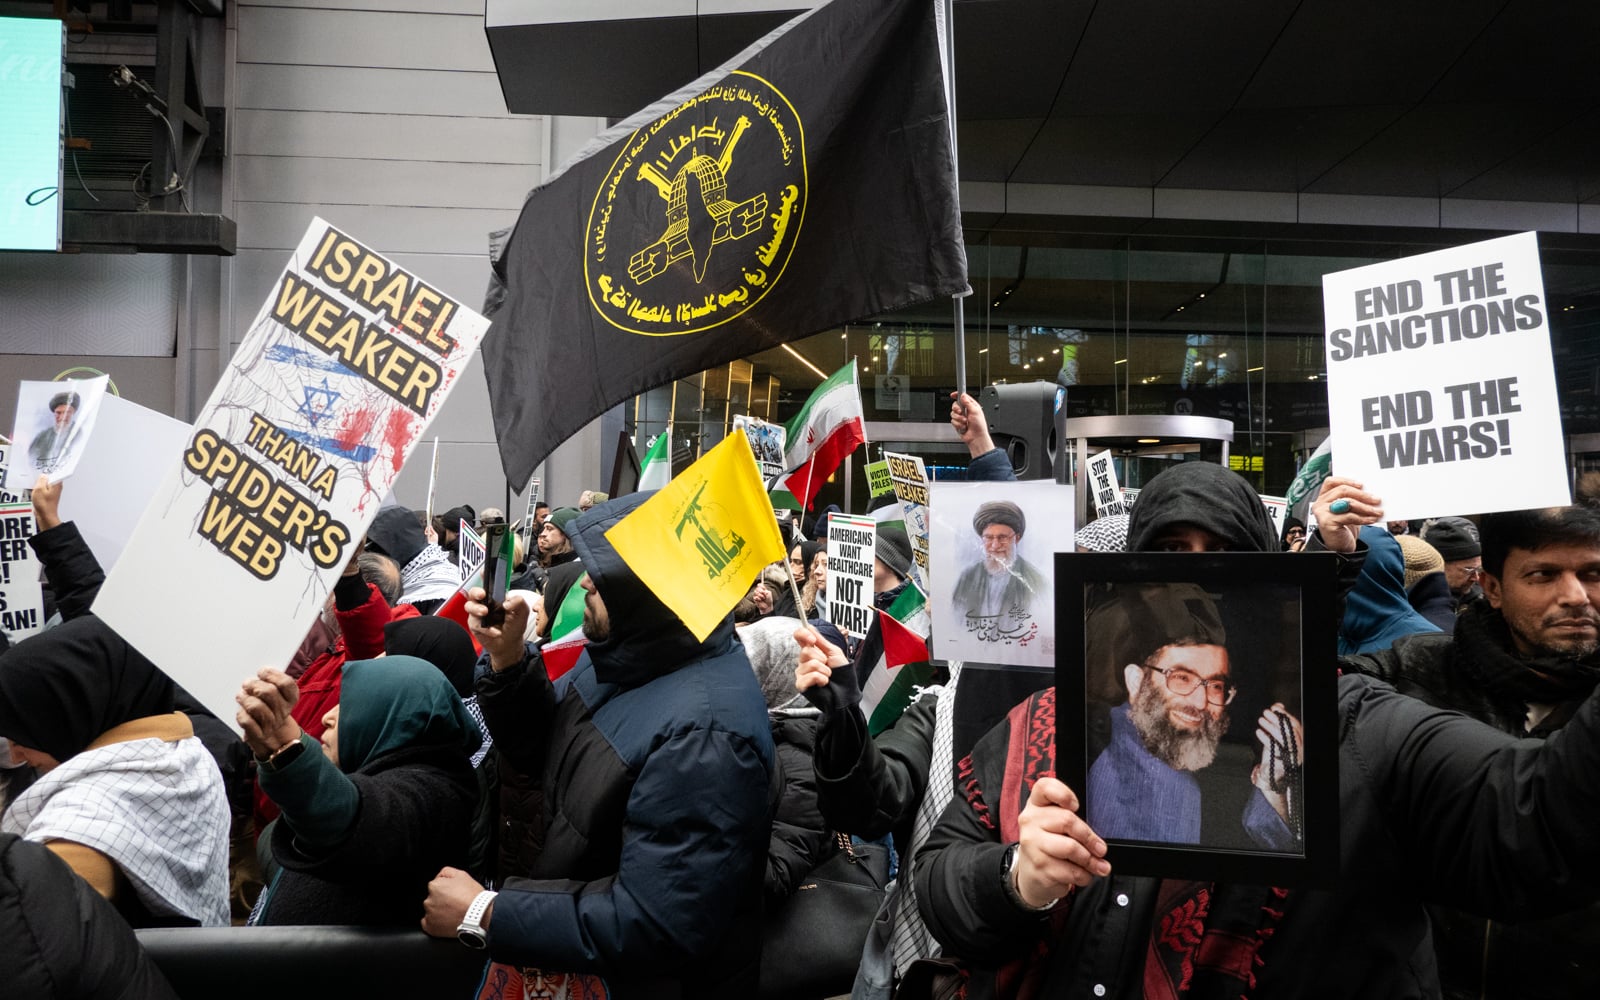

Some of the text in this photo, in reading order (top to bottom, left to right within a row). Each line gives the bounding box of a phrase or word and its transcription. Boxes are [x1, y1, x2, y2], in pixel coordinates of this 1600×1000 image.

[306, 228, 458, 356] ISRAEL
[1354, 262, 1508, 322] END THE
[273, 273, 441, 414] WEAKER
[1329, 294, 1544, 362] SANCTIONS
[1361, 376, 1522, 432] END THE
[246, 413, 337, 499] THAN A
[1373, 418, 1513, 470] WARS!
[888, 456, 924, 482] ISRAEL
[1092, 458, 1108, 476] STOP
[1098, 475, 1110, 489] THE
[186, 431, 349, 567] SPIDER'S
[1097, 506, 1108, 518] ON
[1107, 501, 1123, 516] IRAN
[1099, 489, 1115, 505] WAR
[199, 492, 285, 579] WEB
[830, 527, 873, 547] AMERICANS
[839, 543, 862, 561] WANT
[828, 556, 873, 578] HEALTHCARE
[836, 575, 863, 605] NOT
[830, 601, 868, 635] WAR!
